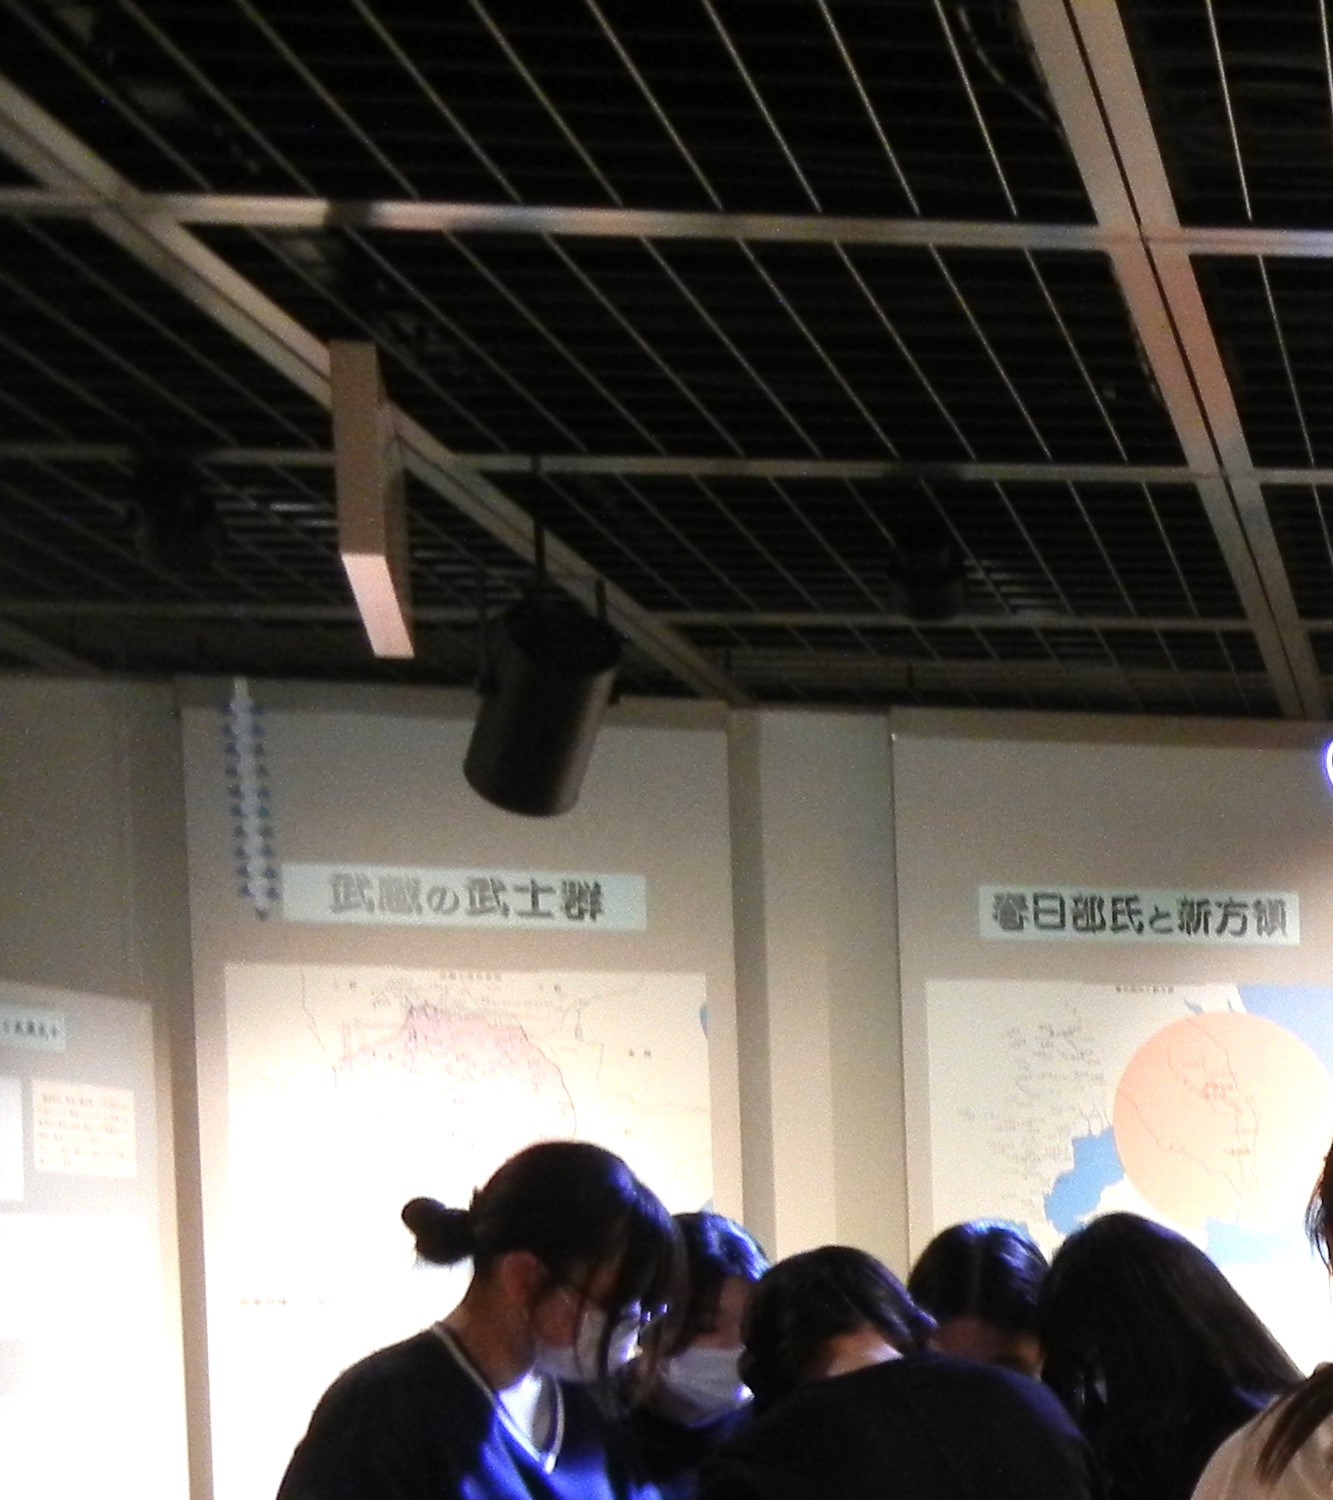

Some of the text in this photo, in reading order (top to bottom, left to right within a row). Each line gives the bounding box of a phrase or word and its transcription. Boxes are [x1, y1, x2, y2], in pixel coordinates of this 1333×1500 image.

[992, 891, 1287, 937] 春日部氏と新方領
